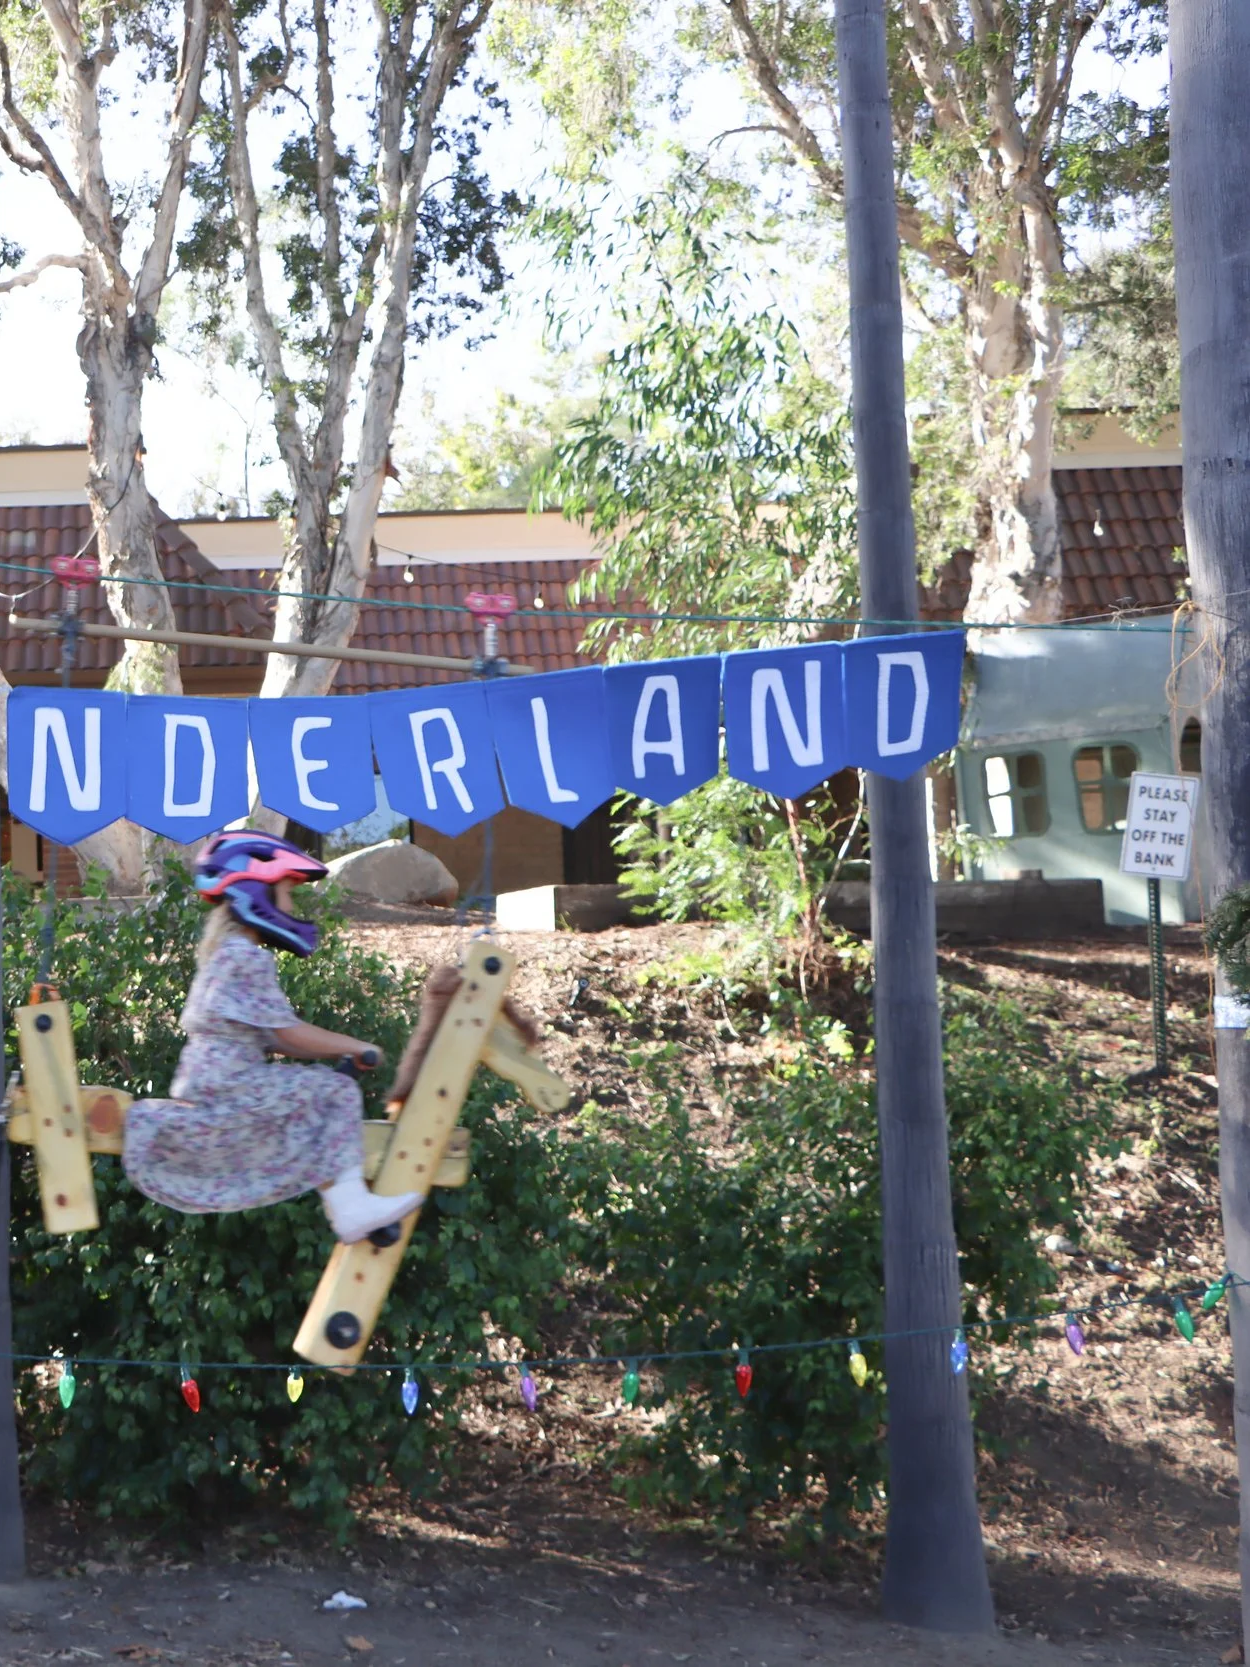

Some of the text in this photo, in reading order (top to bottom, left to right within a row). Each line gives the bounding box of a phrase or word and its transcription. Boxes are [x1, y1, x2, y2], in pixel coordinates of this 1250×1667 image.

[1139, 786, 1188, 802] PLEASE
[1144, 808, 1177, 822] STAY
[1132, 829, 1185, 846] OFF THE
[1135, 852, 1174, 867] BANK
